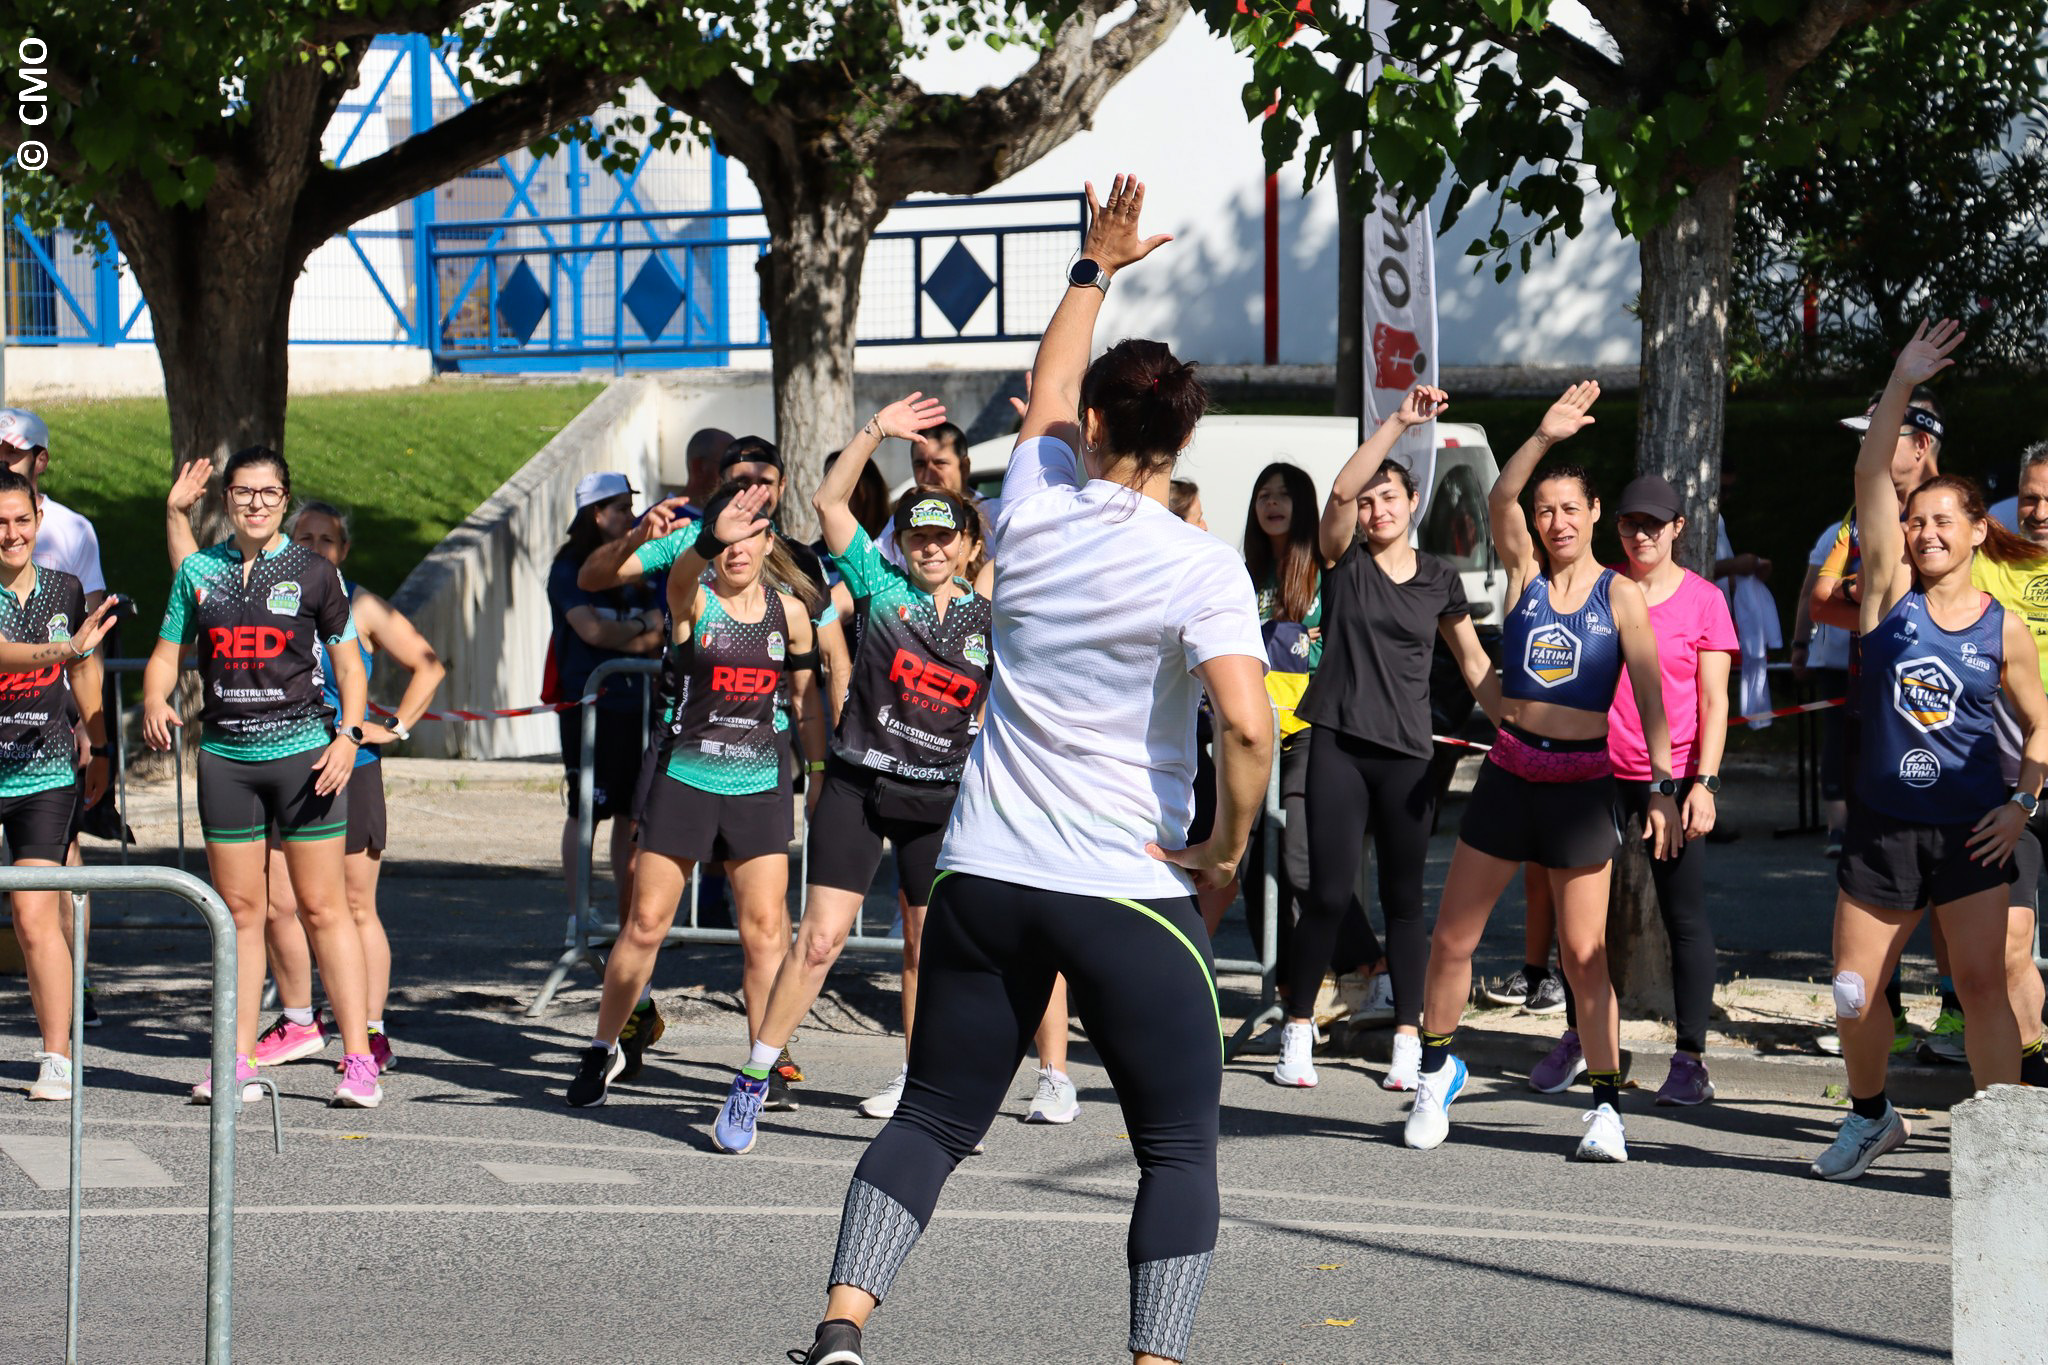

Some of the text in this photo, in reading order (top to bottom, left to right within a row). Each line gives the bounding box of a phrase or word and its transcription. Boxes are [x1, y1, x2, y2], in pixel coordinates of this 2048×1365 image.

[1587, 622, 1612, 635] Fátima
[1531, 647, 1573, 661] FÁTIMA
[1961, 653, 1990, 671] Fátima
[224, 661, 265, 670] GROUP
[1903, 685, 1949, 705] FÁTIMA
[901, 693, 948, 715] GROUP
[888, 718, 952, 748] FATIESTRUTURAS
[1906, 763, 1935, 771] TRAIL
